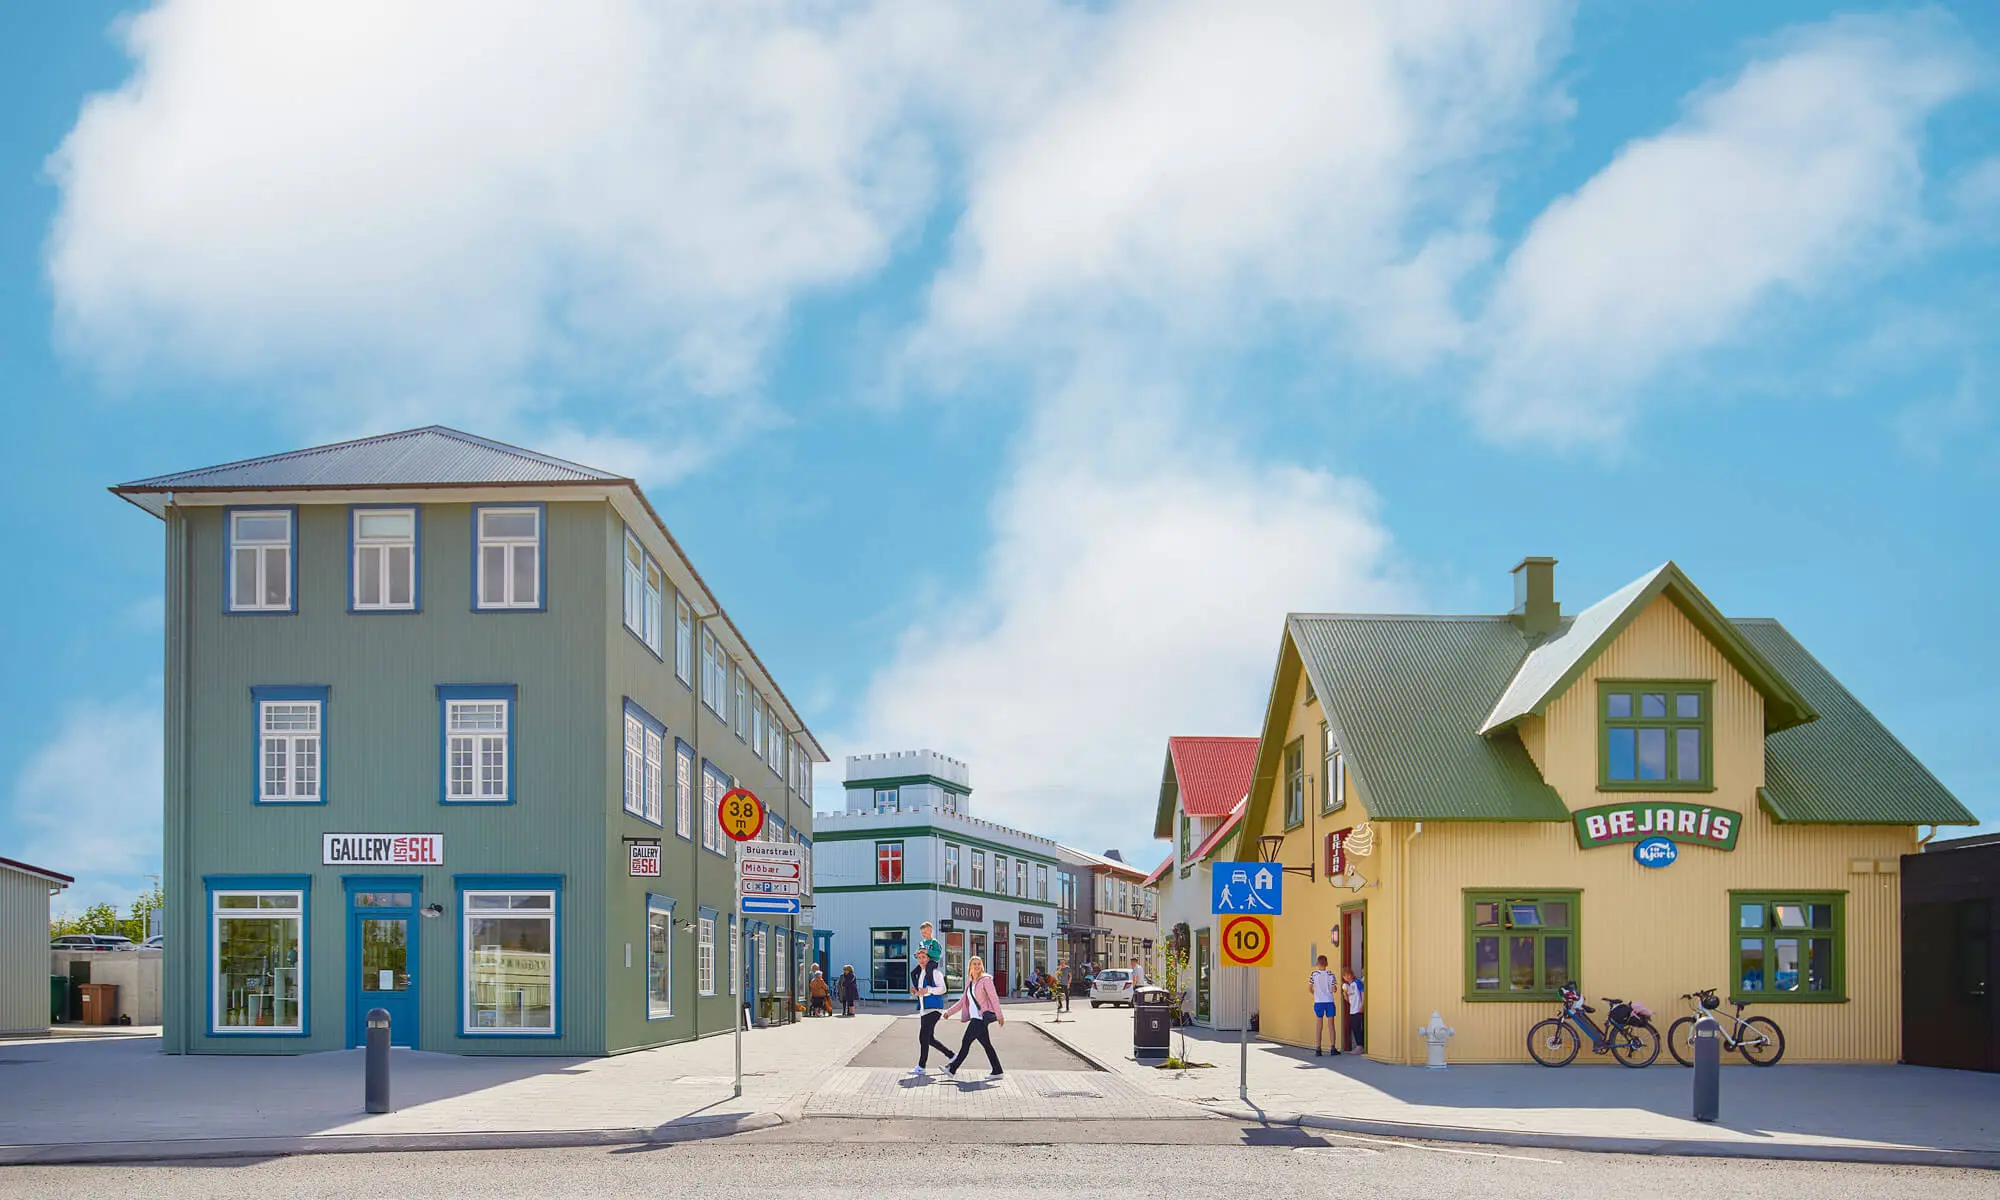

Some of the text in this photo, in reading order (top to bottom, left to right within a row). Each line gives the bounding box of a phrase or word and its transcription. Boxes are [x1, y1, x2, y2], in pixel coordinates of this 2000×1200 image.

[729, 801, 753, 818] 3,8
[736, 820, 746, 828] m
[1585, 808, 1732, 840] BÆJARÍS
[331, 837, 436, 862] GALLERY LISTA SEL
[632, 847, 659, 858] GALLERY
[746, 845, 796, 857] Brúarstræti
[641, 858, 658, 873] SEL
[745, 864, 780, 874] Miðbær
[954, 906, 980, 919] MOTIVO
[1234, 930, 1260, 950] 10
